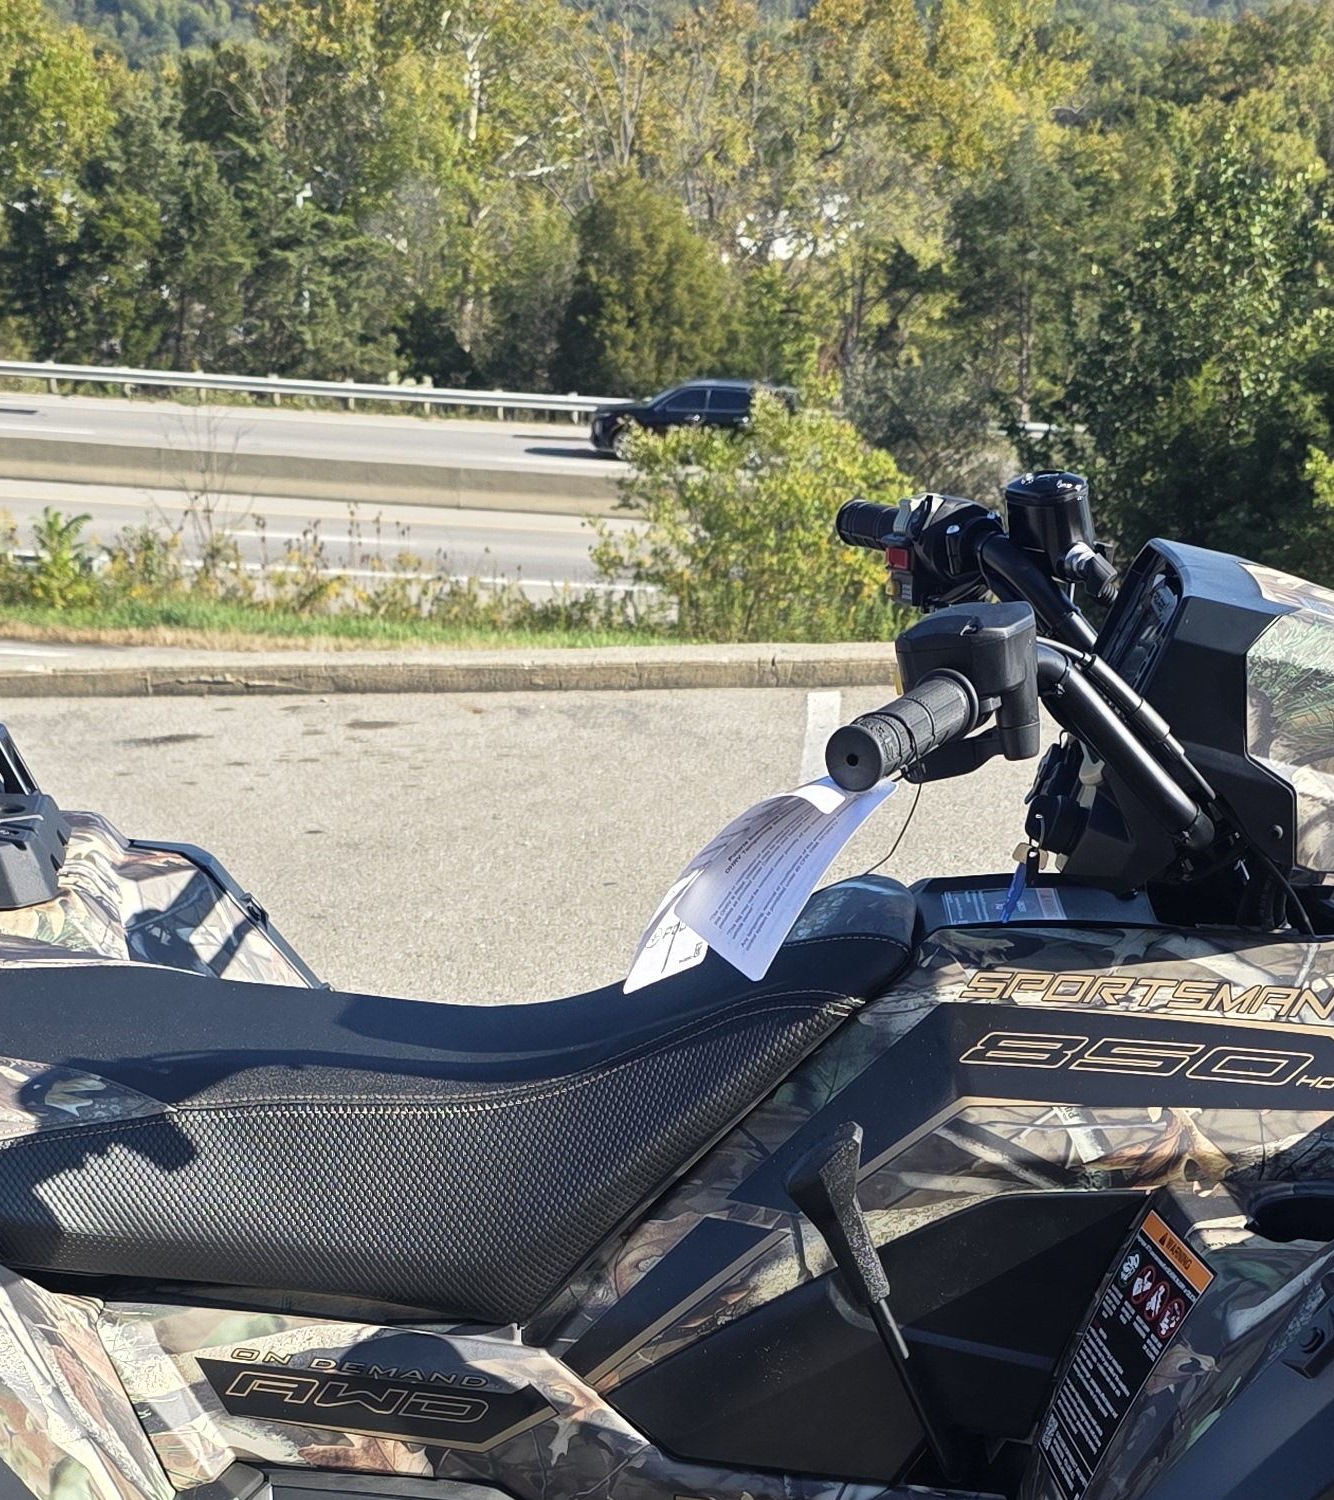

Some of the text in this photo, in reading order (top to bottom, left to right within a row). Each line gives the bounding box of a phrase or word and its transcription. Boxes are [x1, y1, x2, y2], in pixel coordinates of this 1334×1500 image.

[960, 1032, 1314, 1086] 850
[1166, 1236, 1193, 1271] WARNING
[231, 1347, 490, 1389] ON DEMAND
[225, 1370, 490, 1422] AWD
